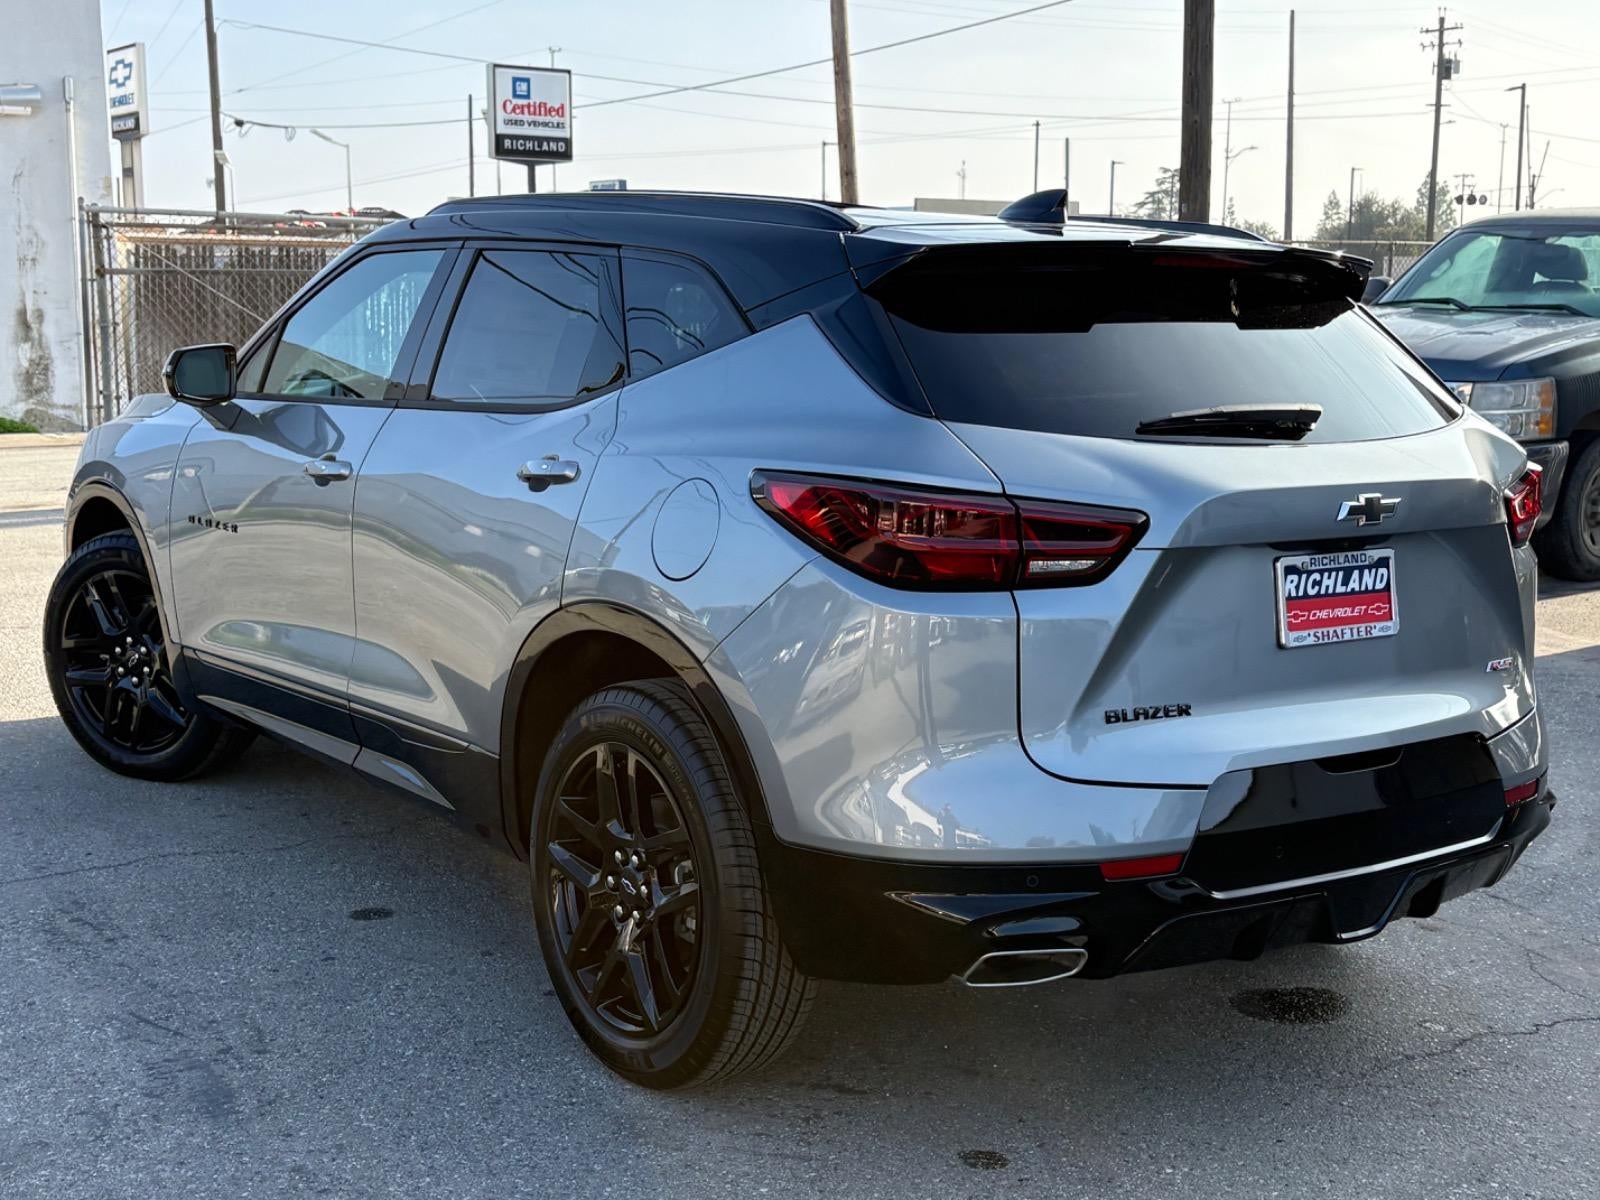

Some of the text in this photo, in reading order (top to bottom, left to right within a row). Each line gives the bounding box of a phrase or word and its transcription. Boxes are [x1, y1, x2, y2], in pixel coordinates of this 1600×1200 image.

[515, 81, 528, 92] GM
[502, 99, 565, 118] Certified
[503, 118, 566, 129] USED VEHICLES
[504, 138, 566, 152] RICHLAND
[1309, 553, 1367, 568] RICHLAND
[1285, 568, 1388, 597] RICHLAND
[1309, 605, 1367, 620] CHEVROLET
[1104, 703, 1192, 725] BLAZER
